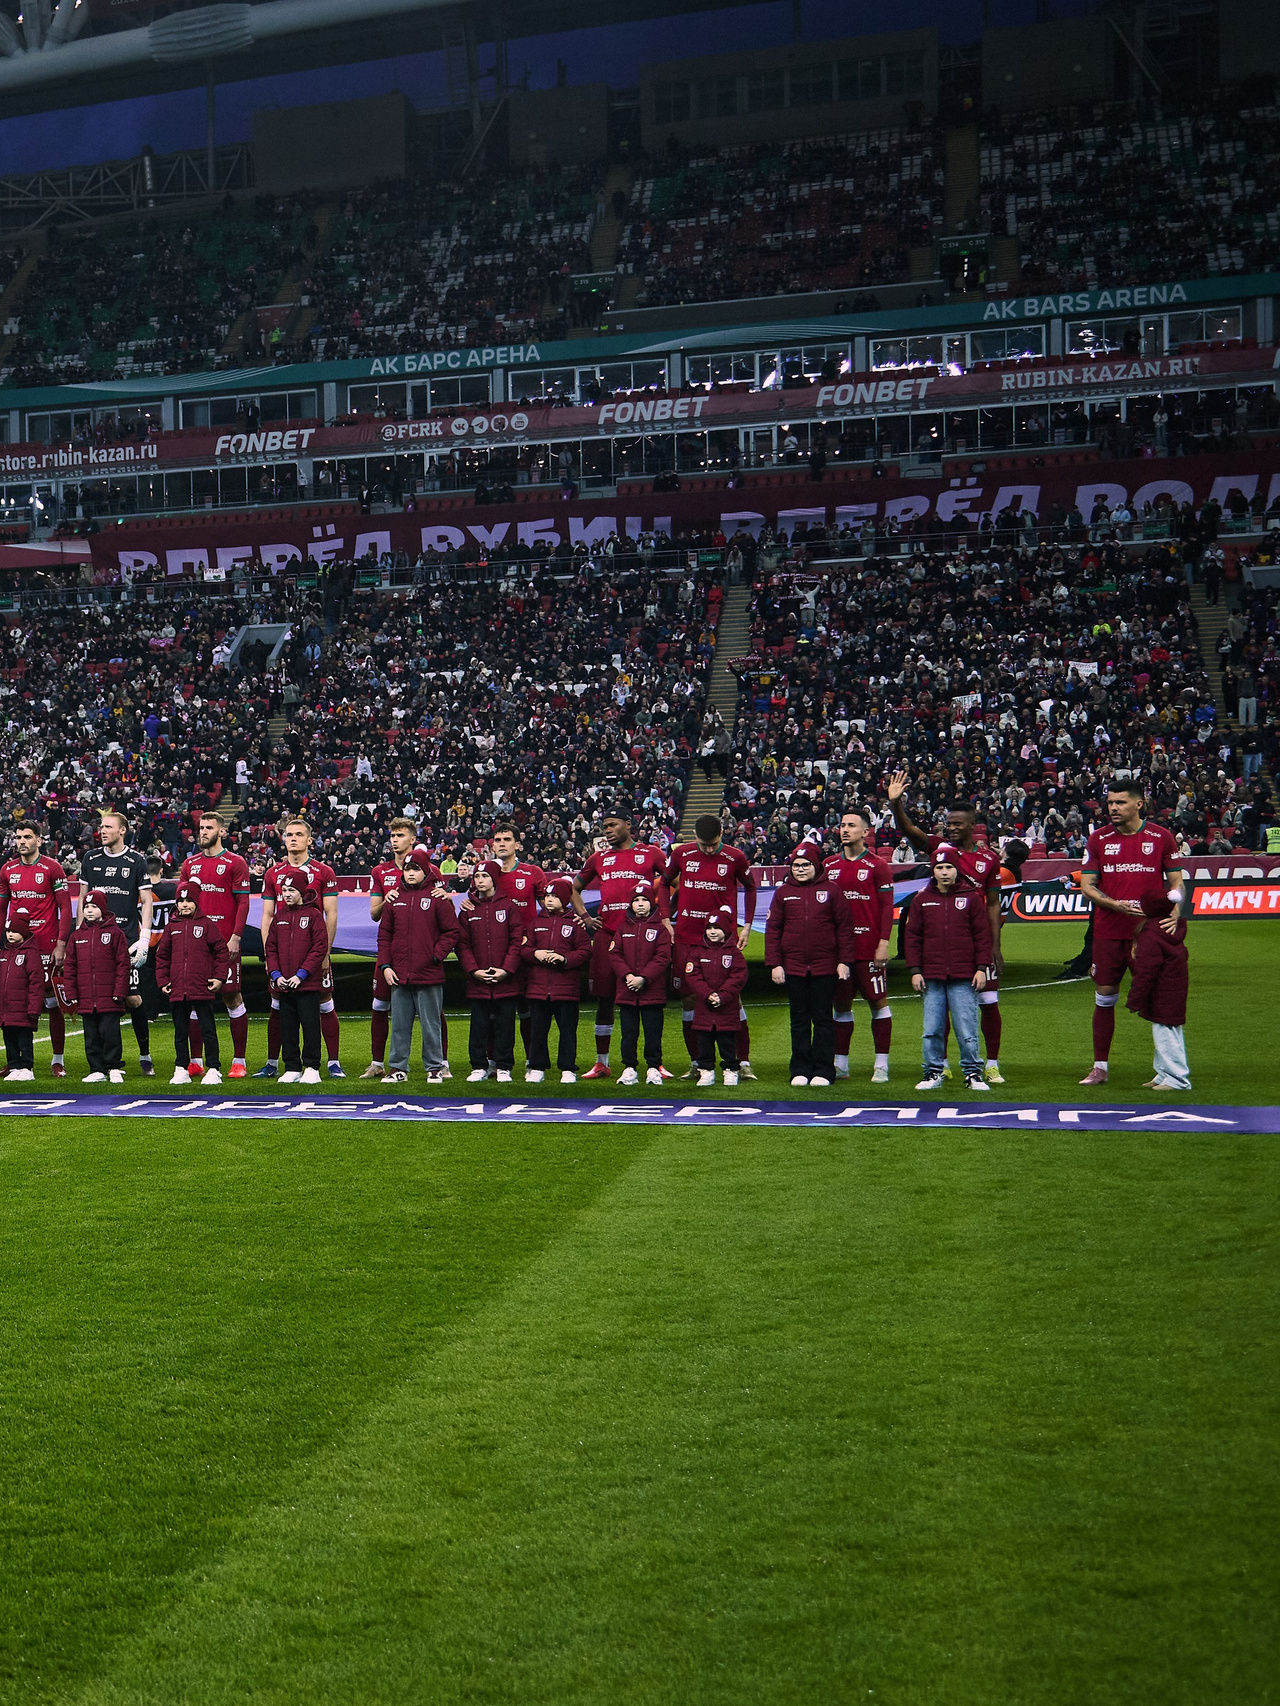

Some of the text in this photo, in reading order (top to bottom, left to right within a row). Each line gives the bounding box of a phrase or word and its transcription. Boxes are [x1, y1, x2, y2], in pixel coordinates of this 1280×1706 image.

[983, 283, 1187, 321] AK BARS ARENA
[370, 344, 541, 376] АК БАРС АРЕНА
[816, 377, 935, 408] FONBET
[598, 396, 710, 425] FONBET
[214, 428, 316, 456] FONBET
[381, 421, 443, 442] @FCRK
[1025, 894, 1093, 913] WINL
[1200, 890, 1280, 910] МАТЧ Т
[870, 974, 885, 994] 11
